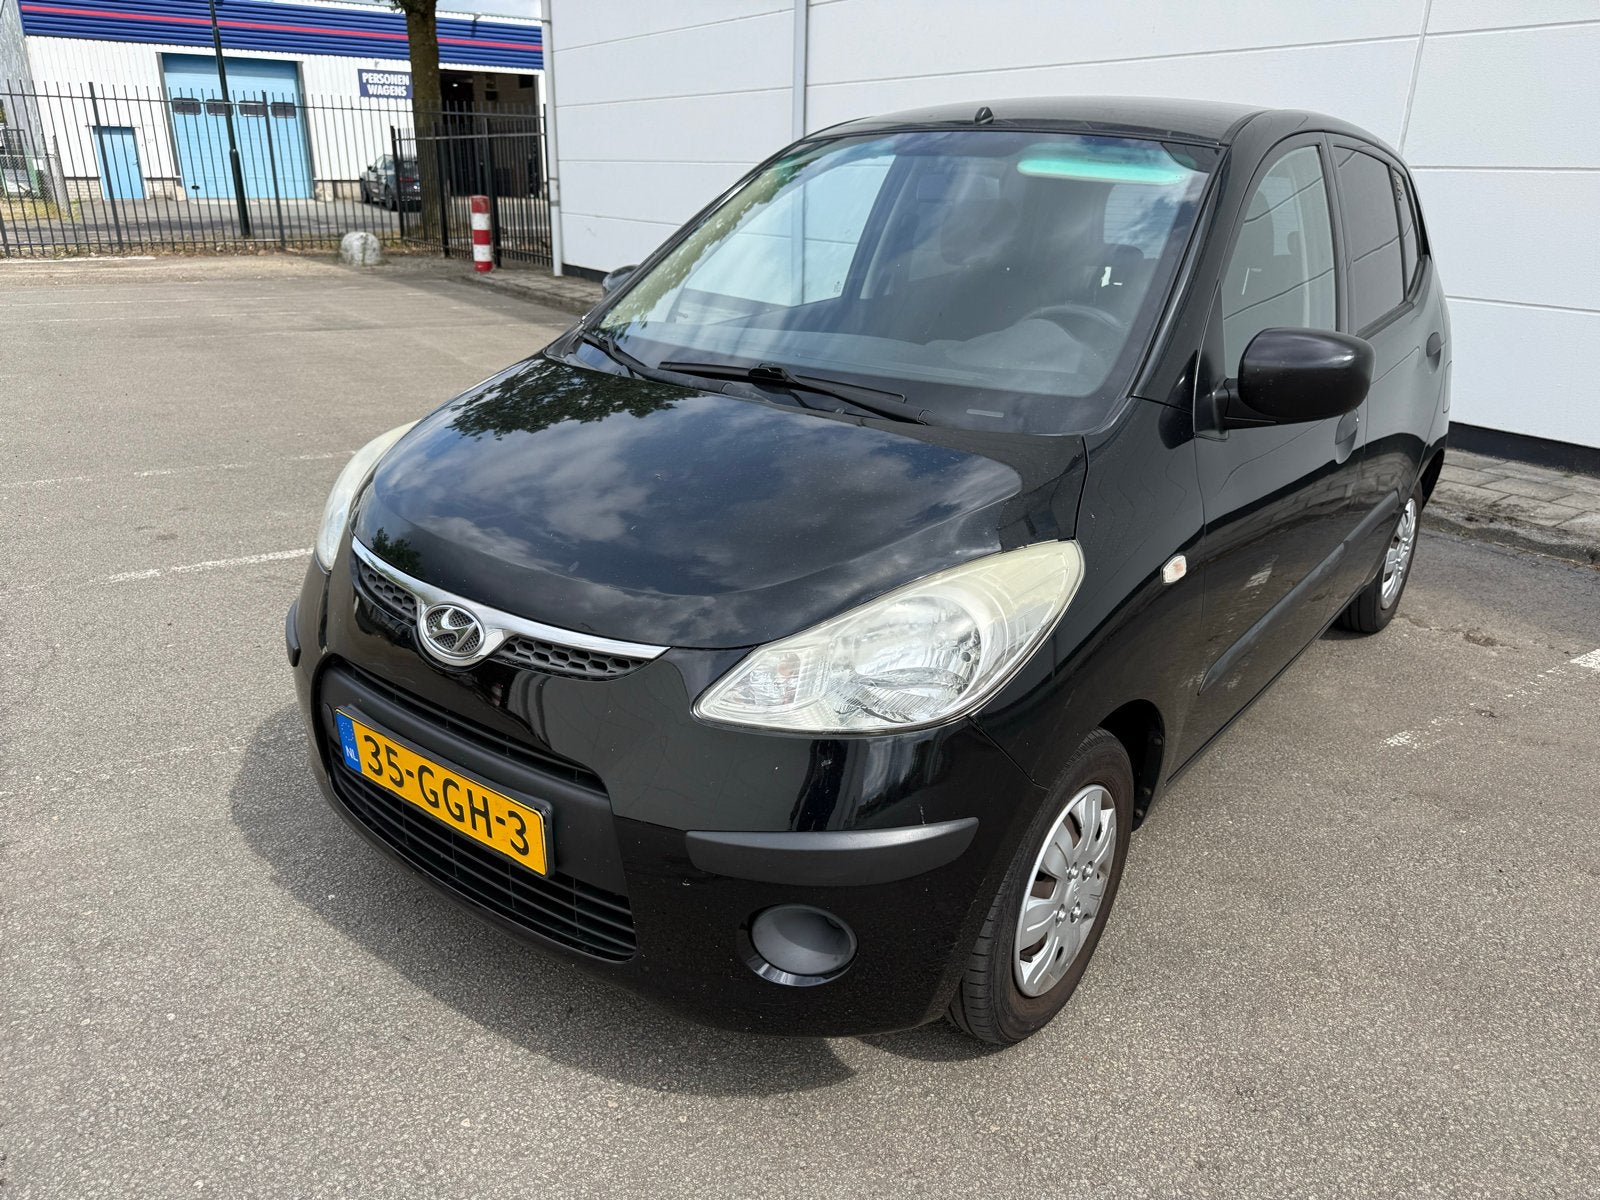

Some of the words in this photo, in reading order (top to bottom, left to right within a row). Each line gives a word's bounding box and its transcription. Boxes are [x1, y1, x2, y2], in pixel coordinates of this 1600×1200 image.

[361, 72, 410, 86] PERSONEN
[367, 84, 407, 97] WAGENS
[345, 745, 359, 762] NL
[363, 734, 530, 856] 35-GGH-3
